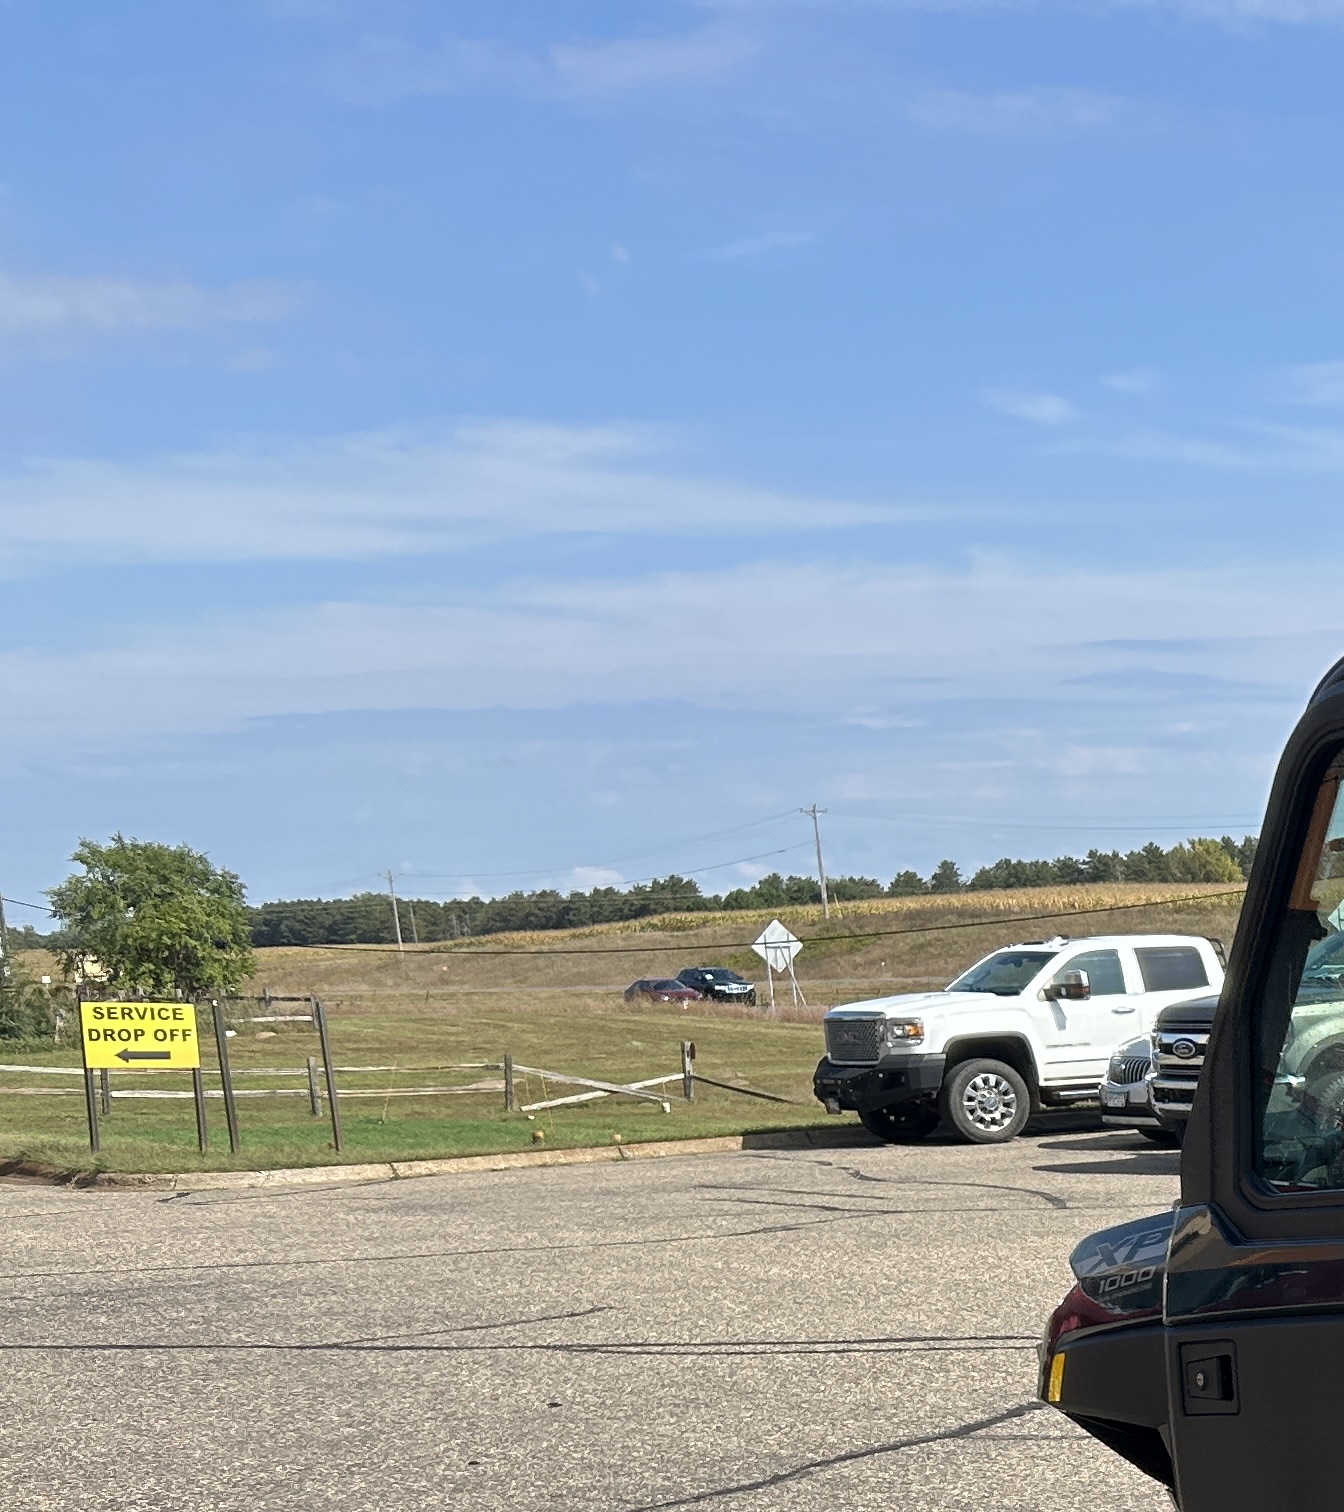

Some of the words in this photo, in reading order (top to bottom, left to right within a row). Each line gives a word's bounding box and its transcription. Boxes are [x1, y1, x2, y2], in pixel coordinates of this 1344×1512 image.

[92, 1006, 184, 1020] SERVICE
[87, 1028, 145, 1041] DROP
[153, 1028, 192, 1041] OFF
[1084, 1226, 1173, 1275] XP
[1098, 1265, 1157, 1294] 1000
